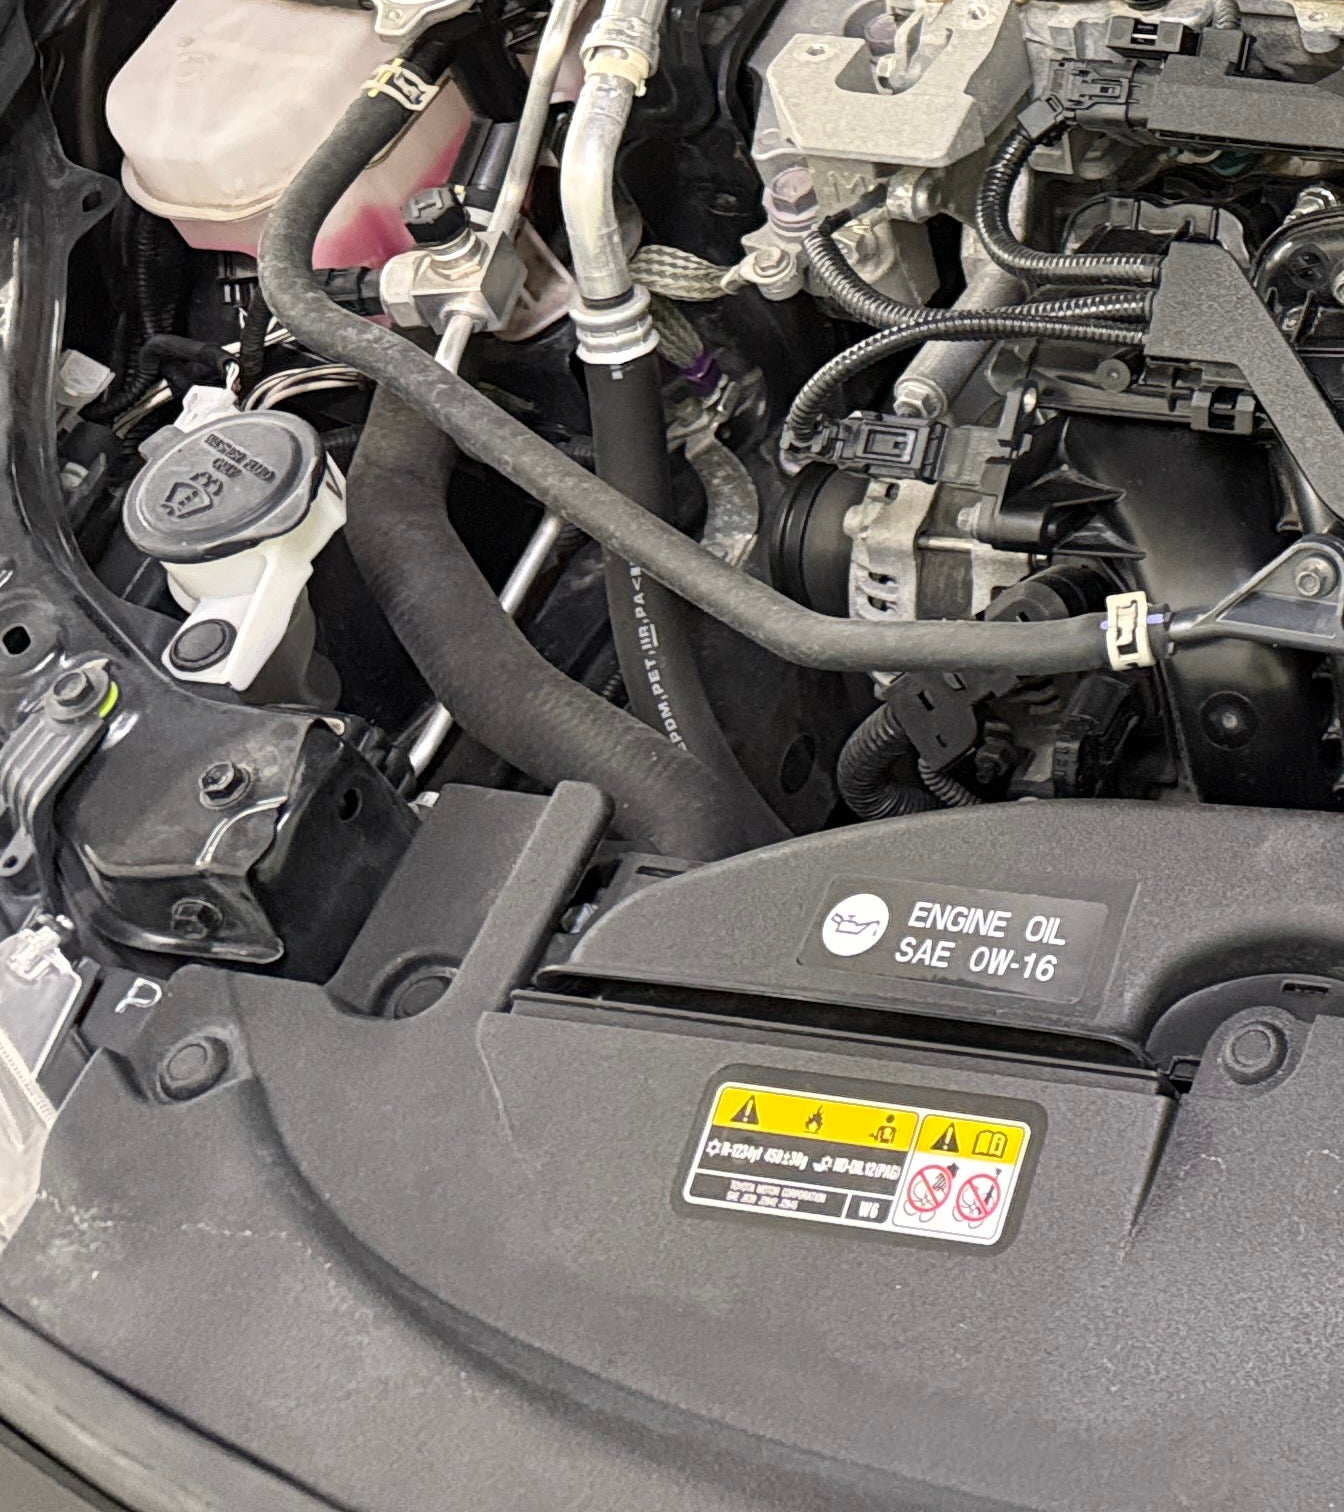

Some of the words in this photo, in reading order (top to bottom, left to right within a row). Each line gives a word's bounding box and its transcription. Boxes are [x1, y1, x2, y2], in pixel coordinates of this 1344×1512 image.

[907, 900, 1013, 940] ENGINE
[1024, 914, 1067, 947] OIL
[894, 936, 953, 969] SAE
[967, 945, 1059, 983] 0W-16
